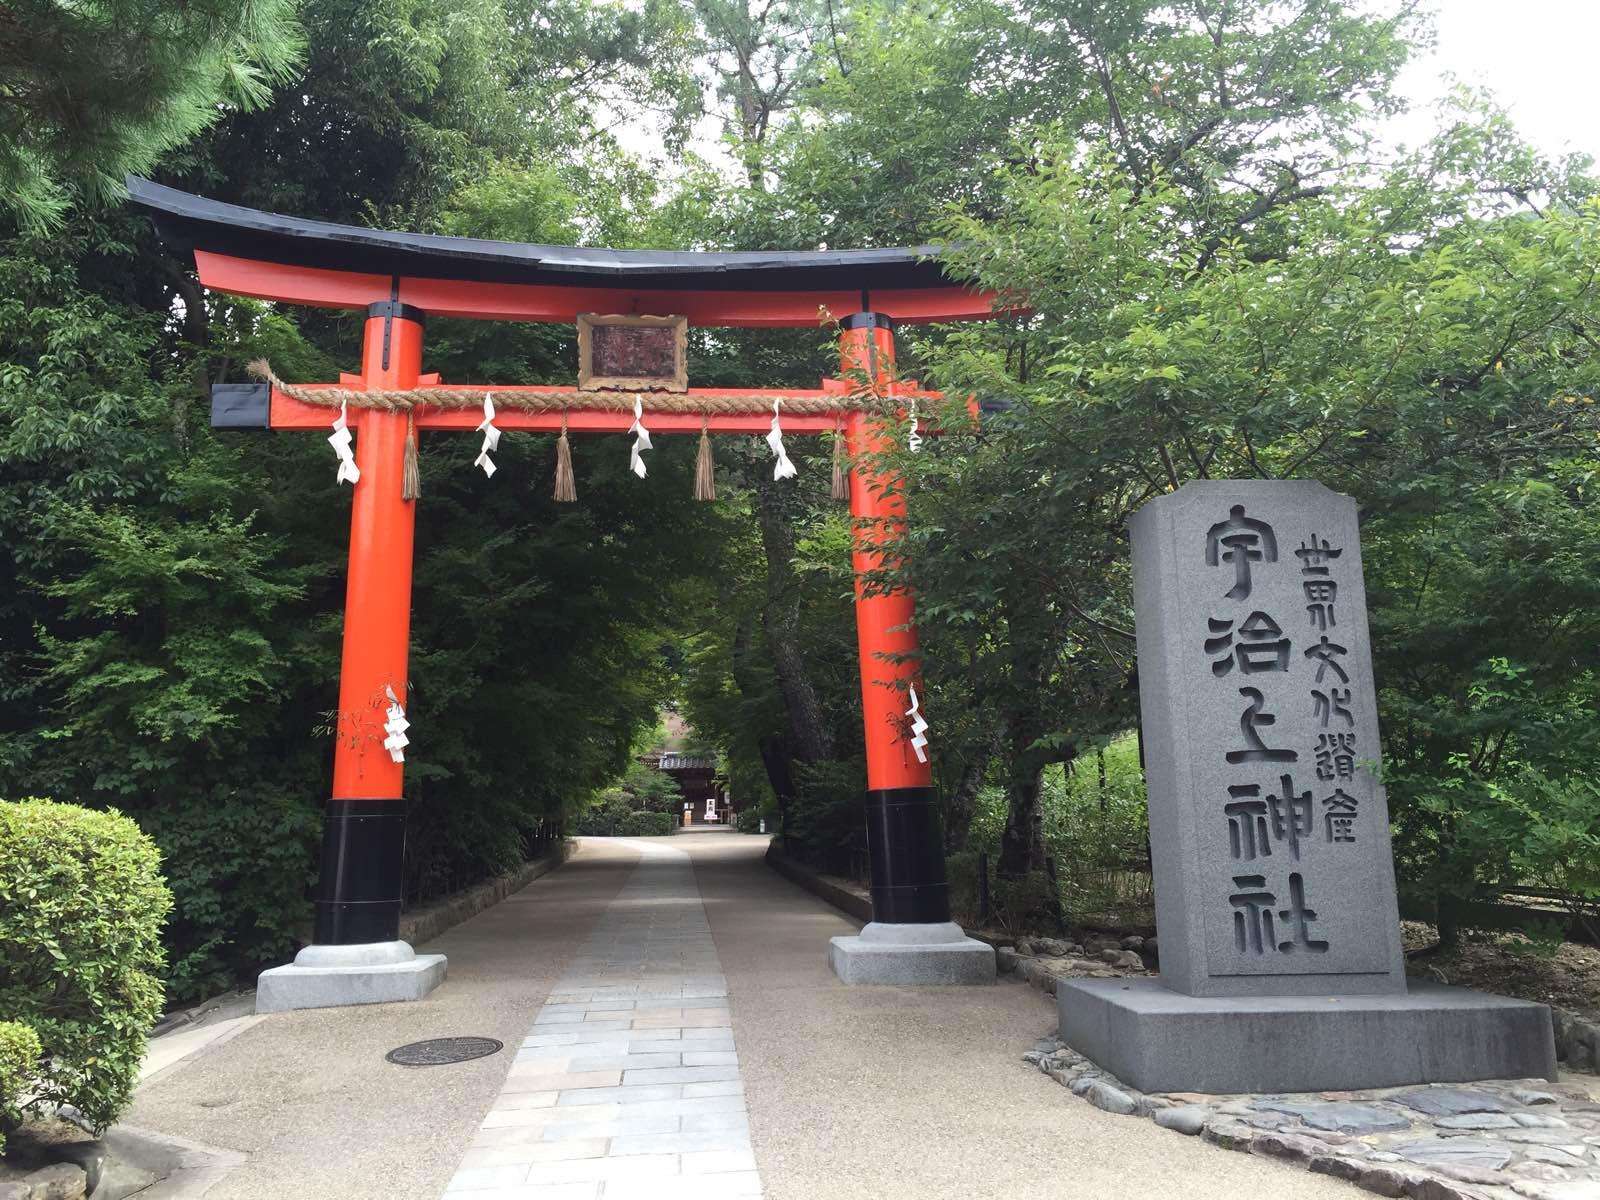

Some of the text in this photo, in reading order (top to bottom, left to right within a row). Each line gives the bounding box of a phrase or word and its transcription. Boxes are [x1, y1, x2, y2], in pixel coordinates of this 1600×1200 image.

[1204, 504, 1330, 954] 宇治上神社
